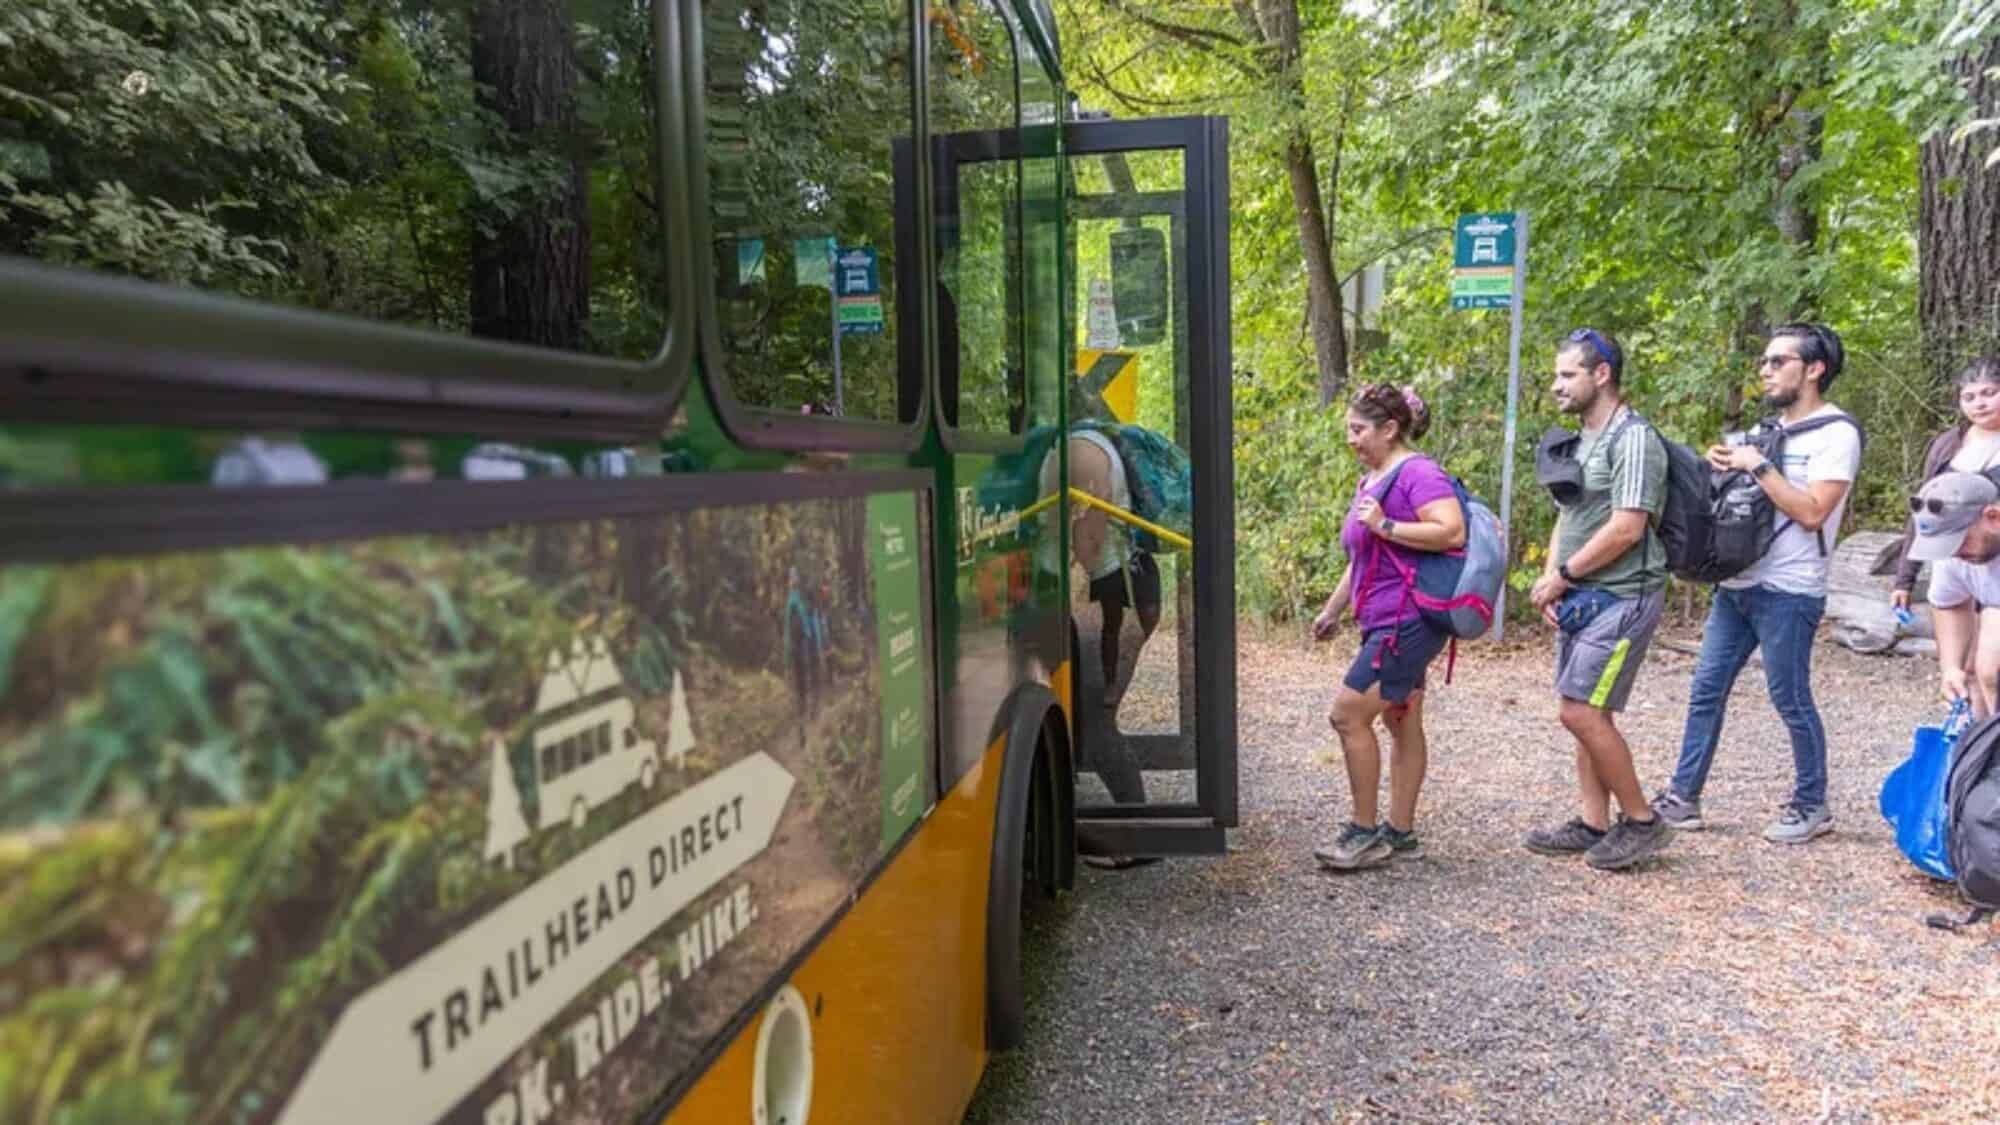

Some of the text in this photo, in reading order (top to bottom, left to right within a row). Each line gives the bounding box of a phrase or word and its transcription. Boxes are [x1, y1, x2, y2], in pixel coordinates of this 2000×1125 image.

[411, 796, 745, 1072] TRAILHEAD DIRECT
[571, 956, 672, 1079] RIDE.
[677, 883, 759, 981] HIKE.
